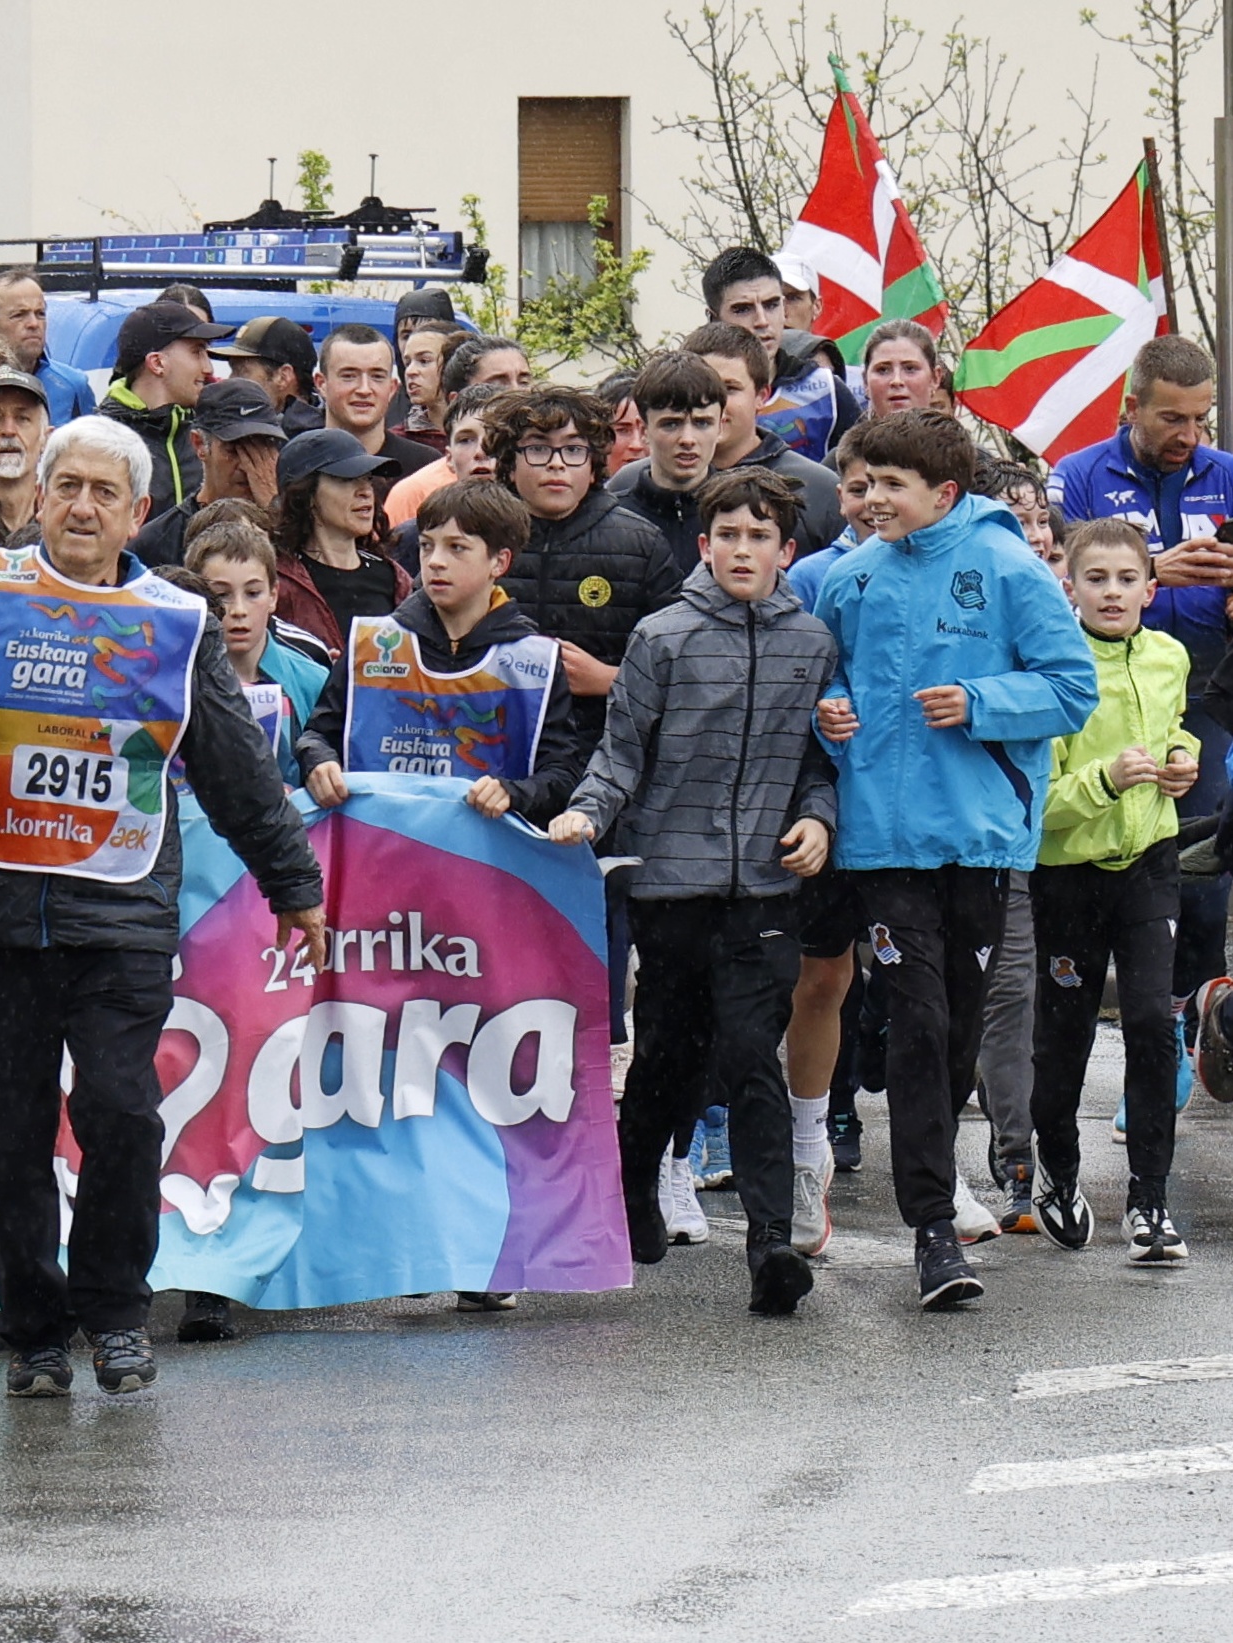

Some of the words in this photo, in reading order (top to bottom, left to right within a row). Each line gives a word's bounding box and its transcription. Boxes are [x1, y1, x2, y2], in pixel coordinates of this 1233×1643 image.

[936, 618, 989, 640] Kutxabank
[5, 640, 88, 666] Euskara
[11, 659, 87, 690] gara
[514, 655, 549, 680] eitb
[247, 690, 276, 704] itb
[38, 723, 87, 740] LABORAL
[25, 752, 113, 803] 2915
[109, 821, 150, 852] aek
